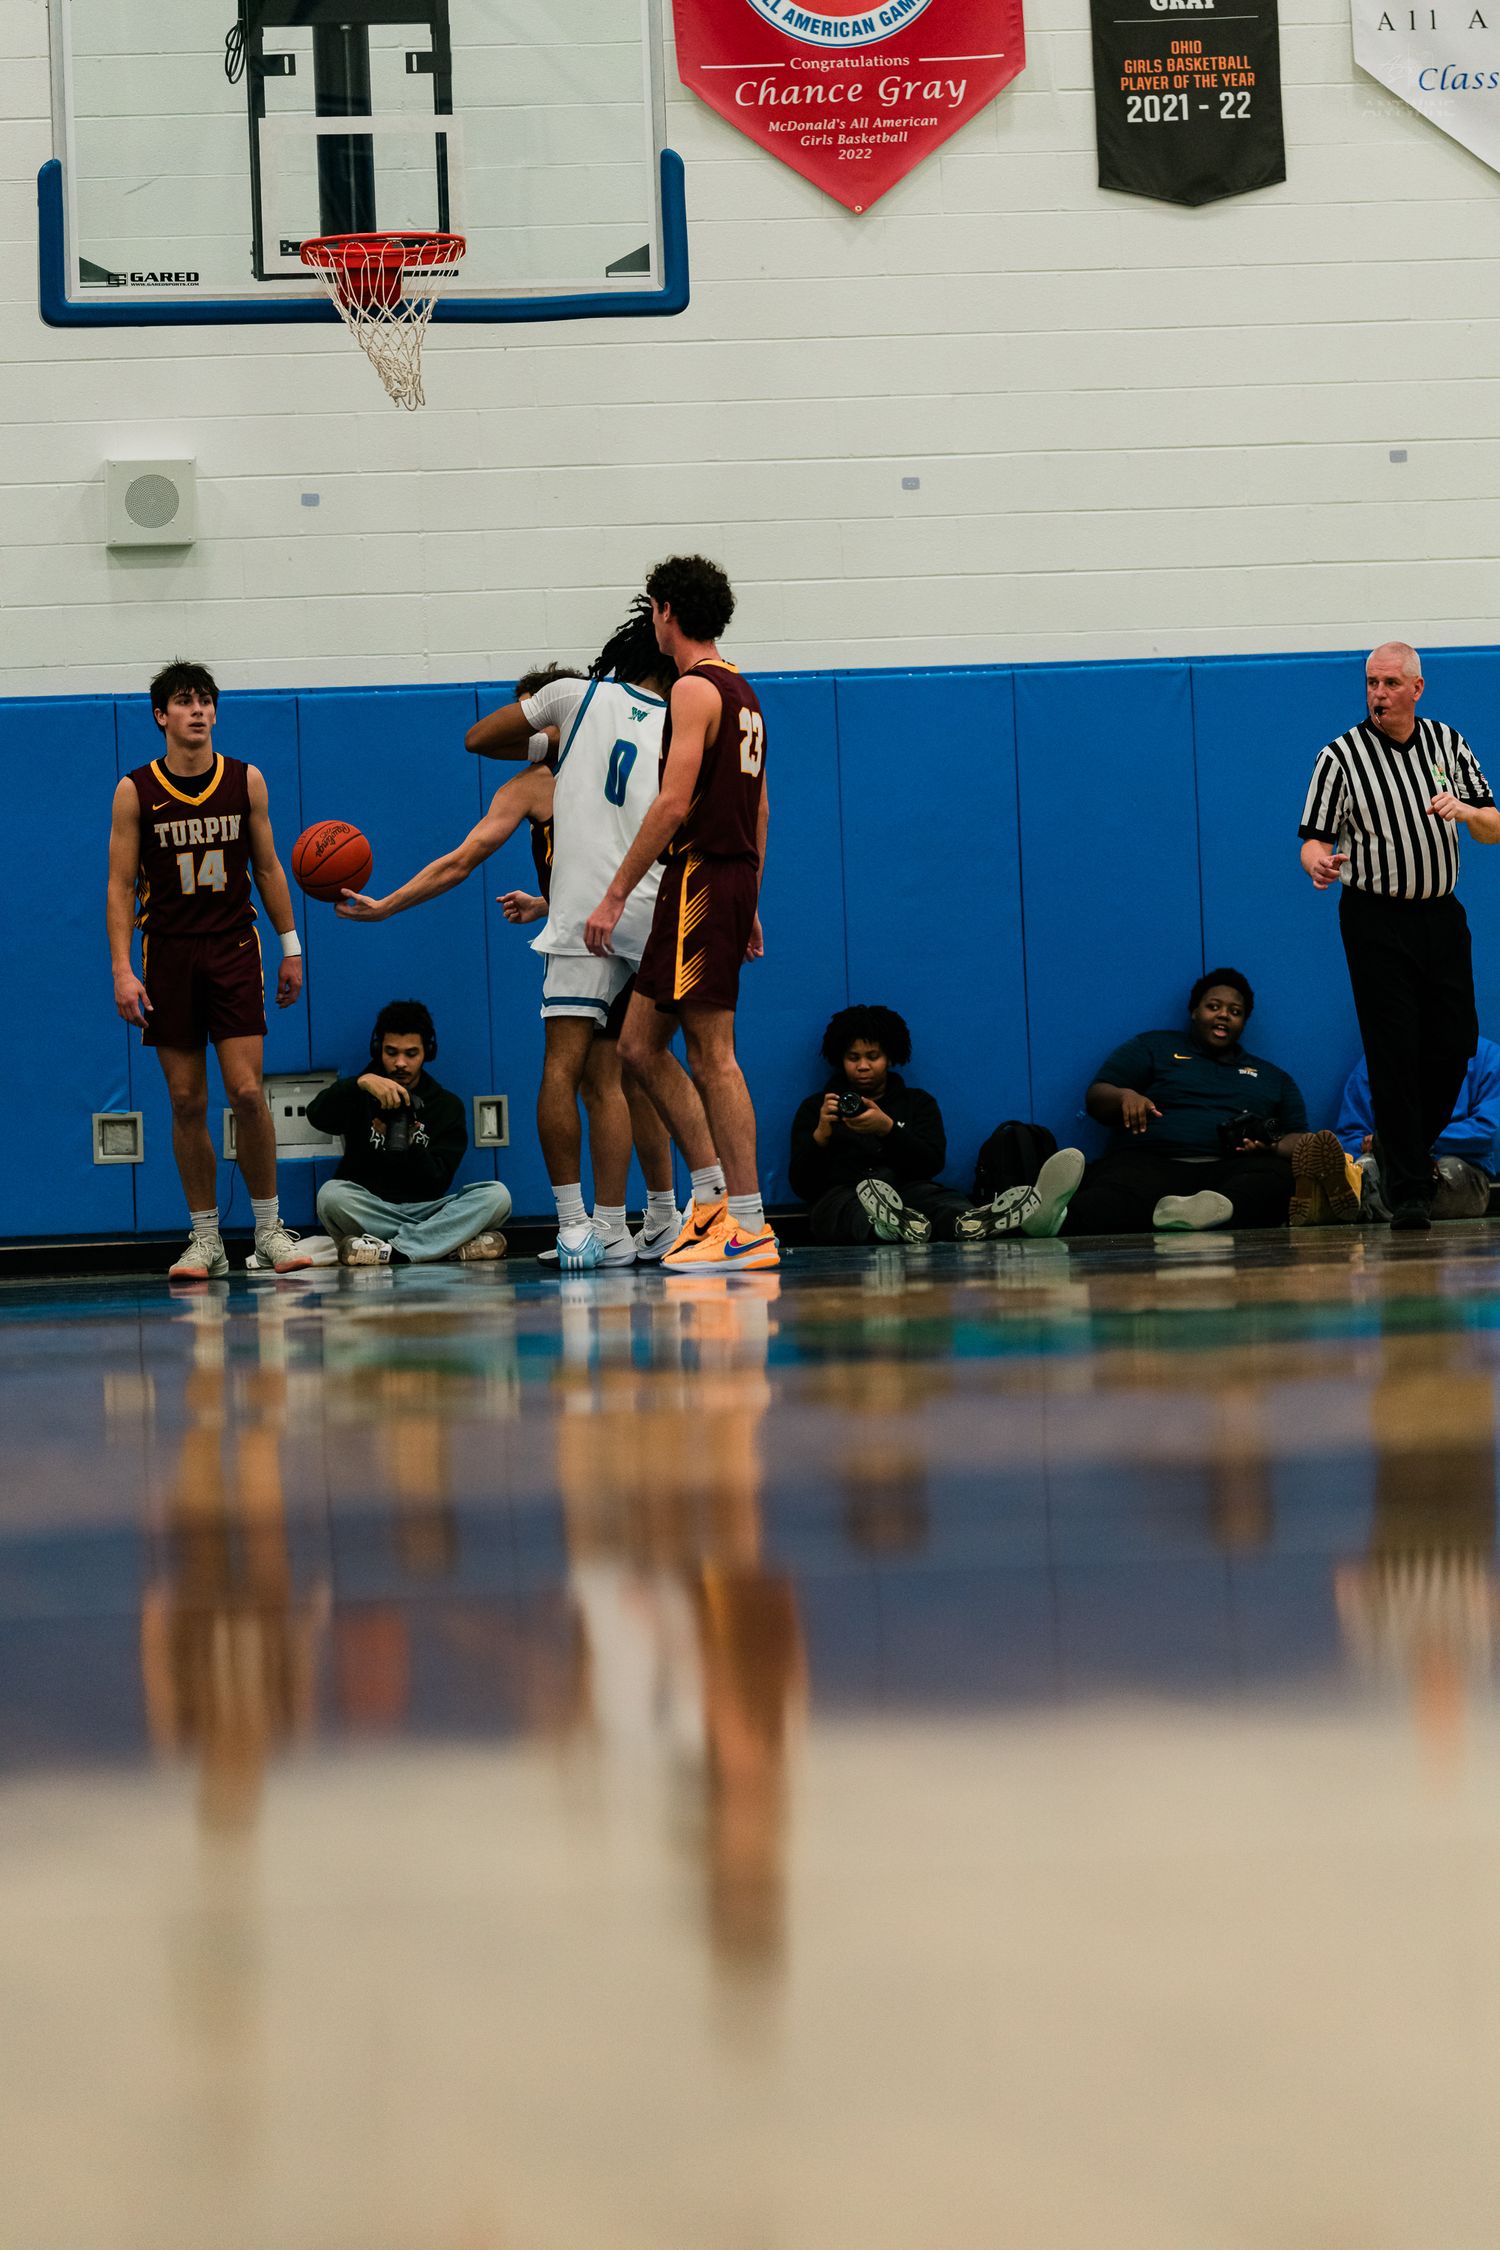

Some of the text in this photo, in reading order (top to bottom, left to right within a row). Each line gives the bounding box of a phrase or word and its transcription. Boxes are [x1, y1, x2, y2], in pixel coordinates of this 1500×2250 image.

[782, 8, 876, 37] AMERICAN
[879, 0, 920, 27] GAM
[1378, 9, 1440, 31] All
[1171, 40, 1202, 54] OHIO
[790, 55, 910, 72] Congratulations
[1124, 55, 1251, 73] GIRLS BASKETBALL
[1120, 72, 1256, 91] PLAYER OF THE YEAR
[1418, 64, 1500, 91] Class
[735, 76, 967, 108] Chance Gray
[1126, 93, 1189, 123] 2021
[1219, 91, 1251, 119] 22
[768, 116, 938, 132] McDonald's All American
[800, 131, 908, 146] Girls Basketball
[838, 148, 872, 160] 2022
[130, 272, 199, 282] GARED
[739, 706, 764, 778] 23
[604, 738, 638, 808] 0
[154, 814, 241, 848] TURPIN
[176, 849, 228, 895] 14
